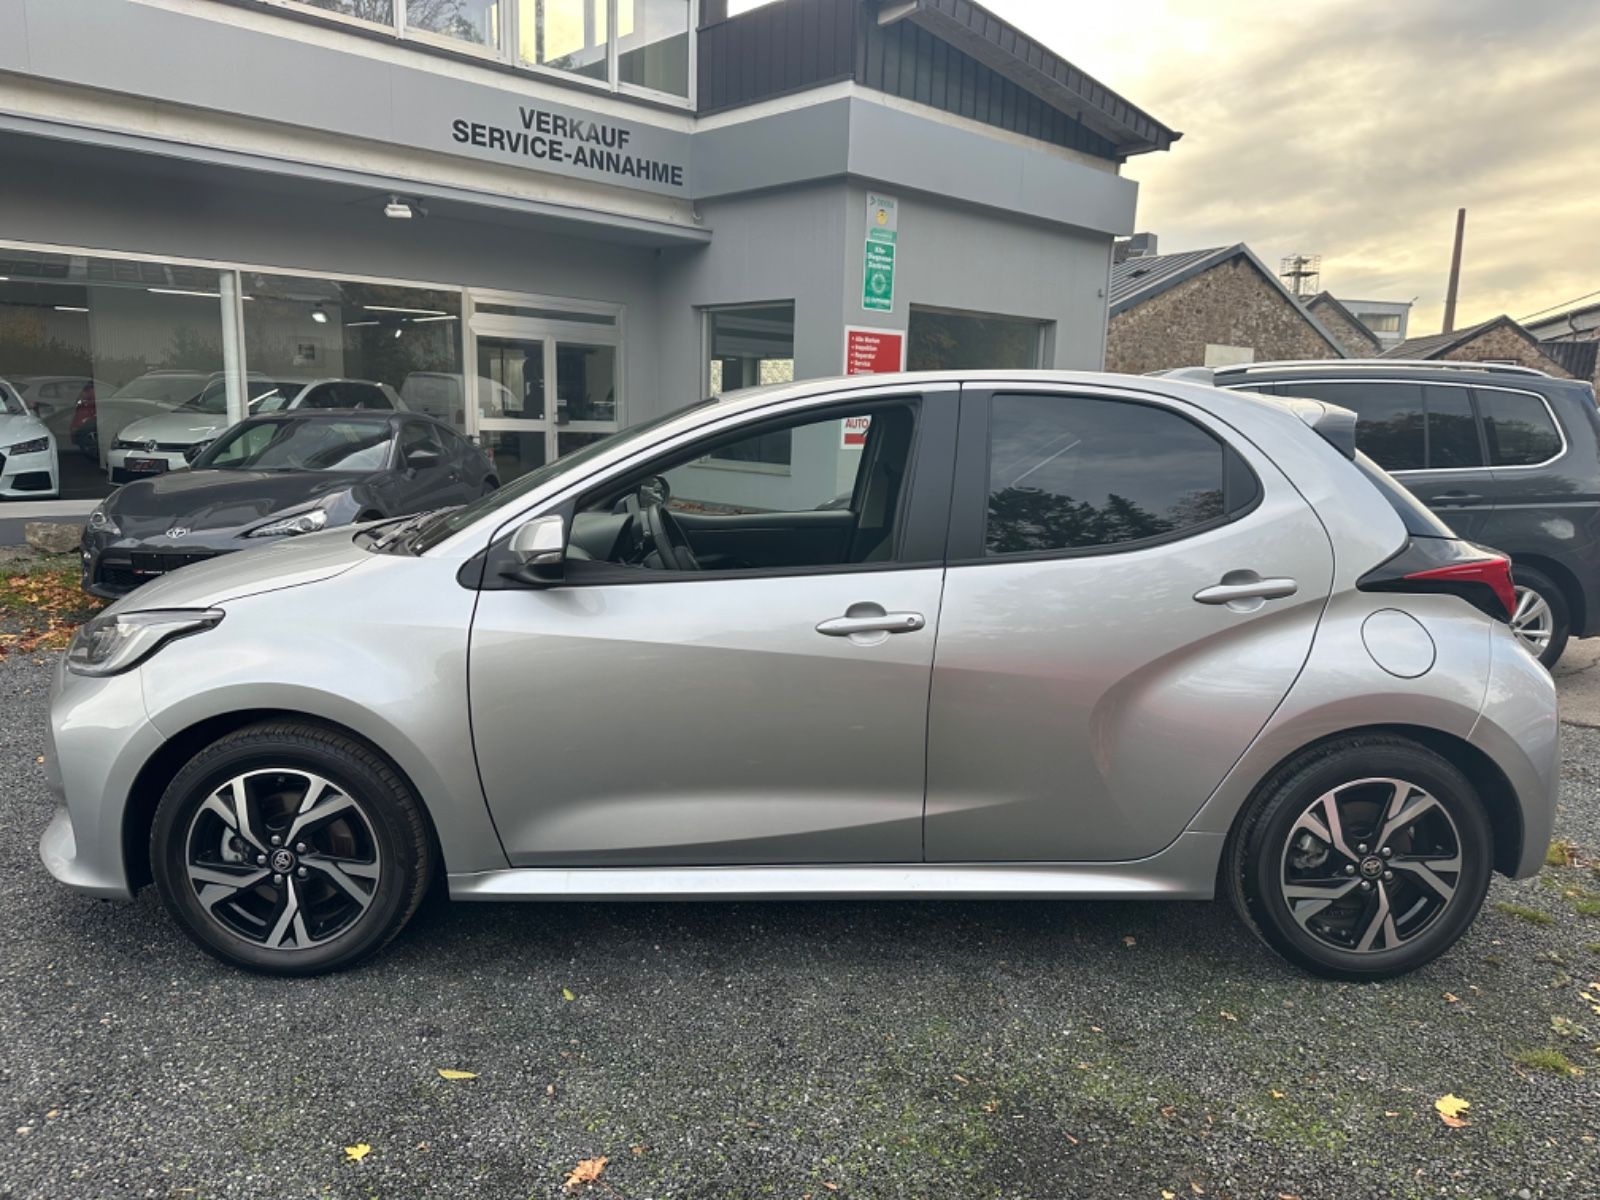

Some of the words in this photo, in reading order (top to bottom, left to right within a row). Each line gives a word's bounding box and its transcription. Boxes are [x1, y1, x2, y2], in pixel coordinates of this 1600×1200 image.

[519, 106, 630, 150] VERKAUF
[452, 119, 683, 186] SERVICE-ANNAHME
[845, 418, 869, 428] AUTO
